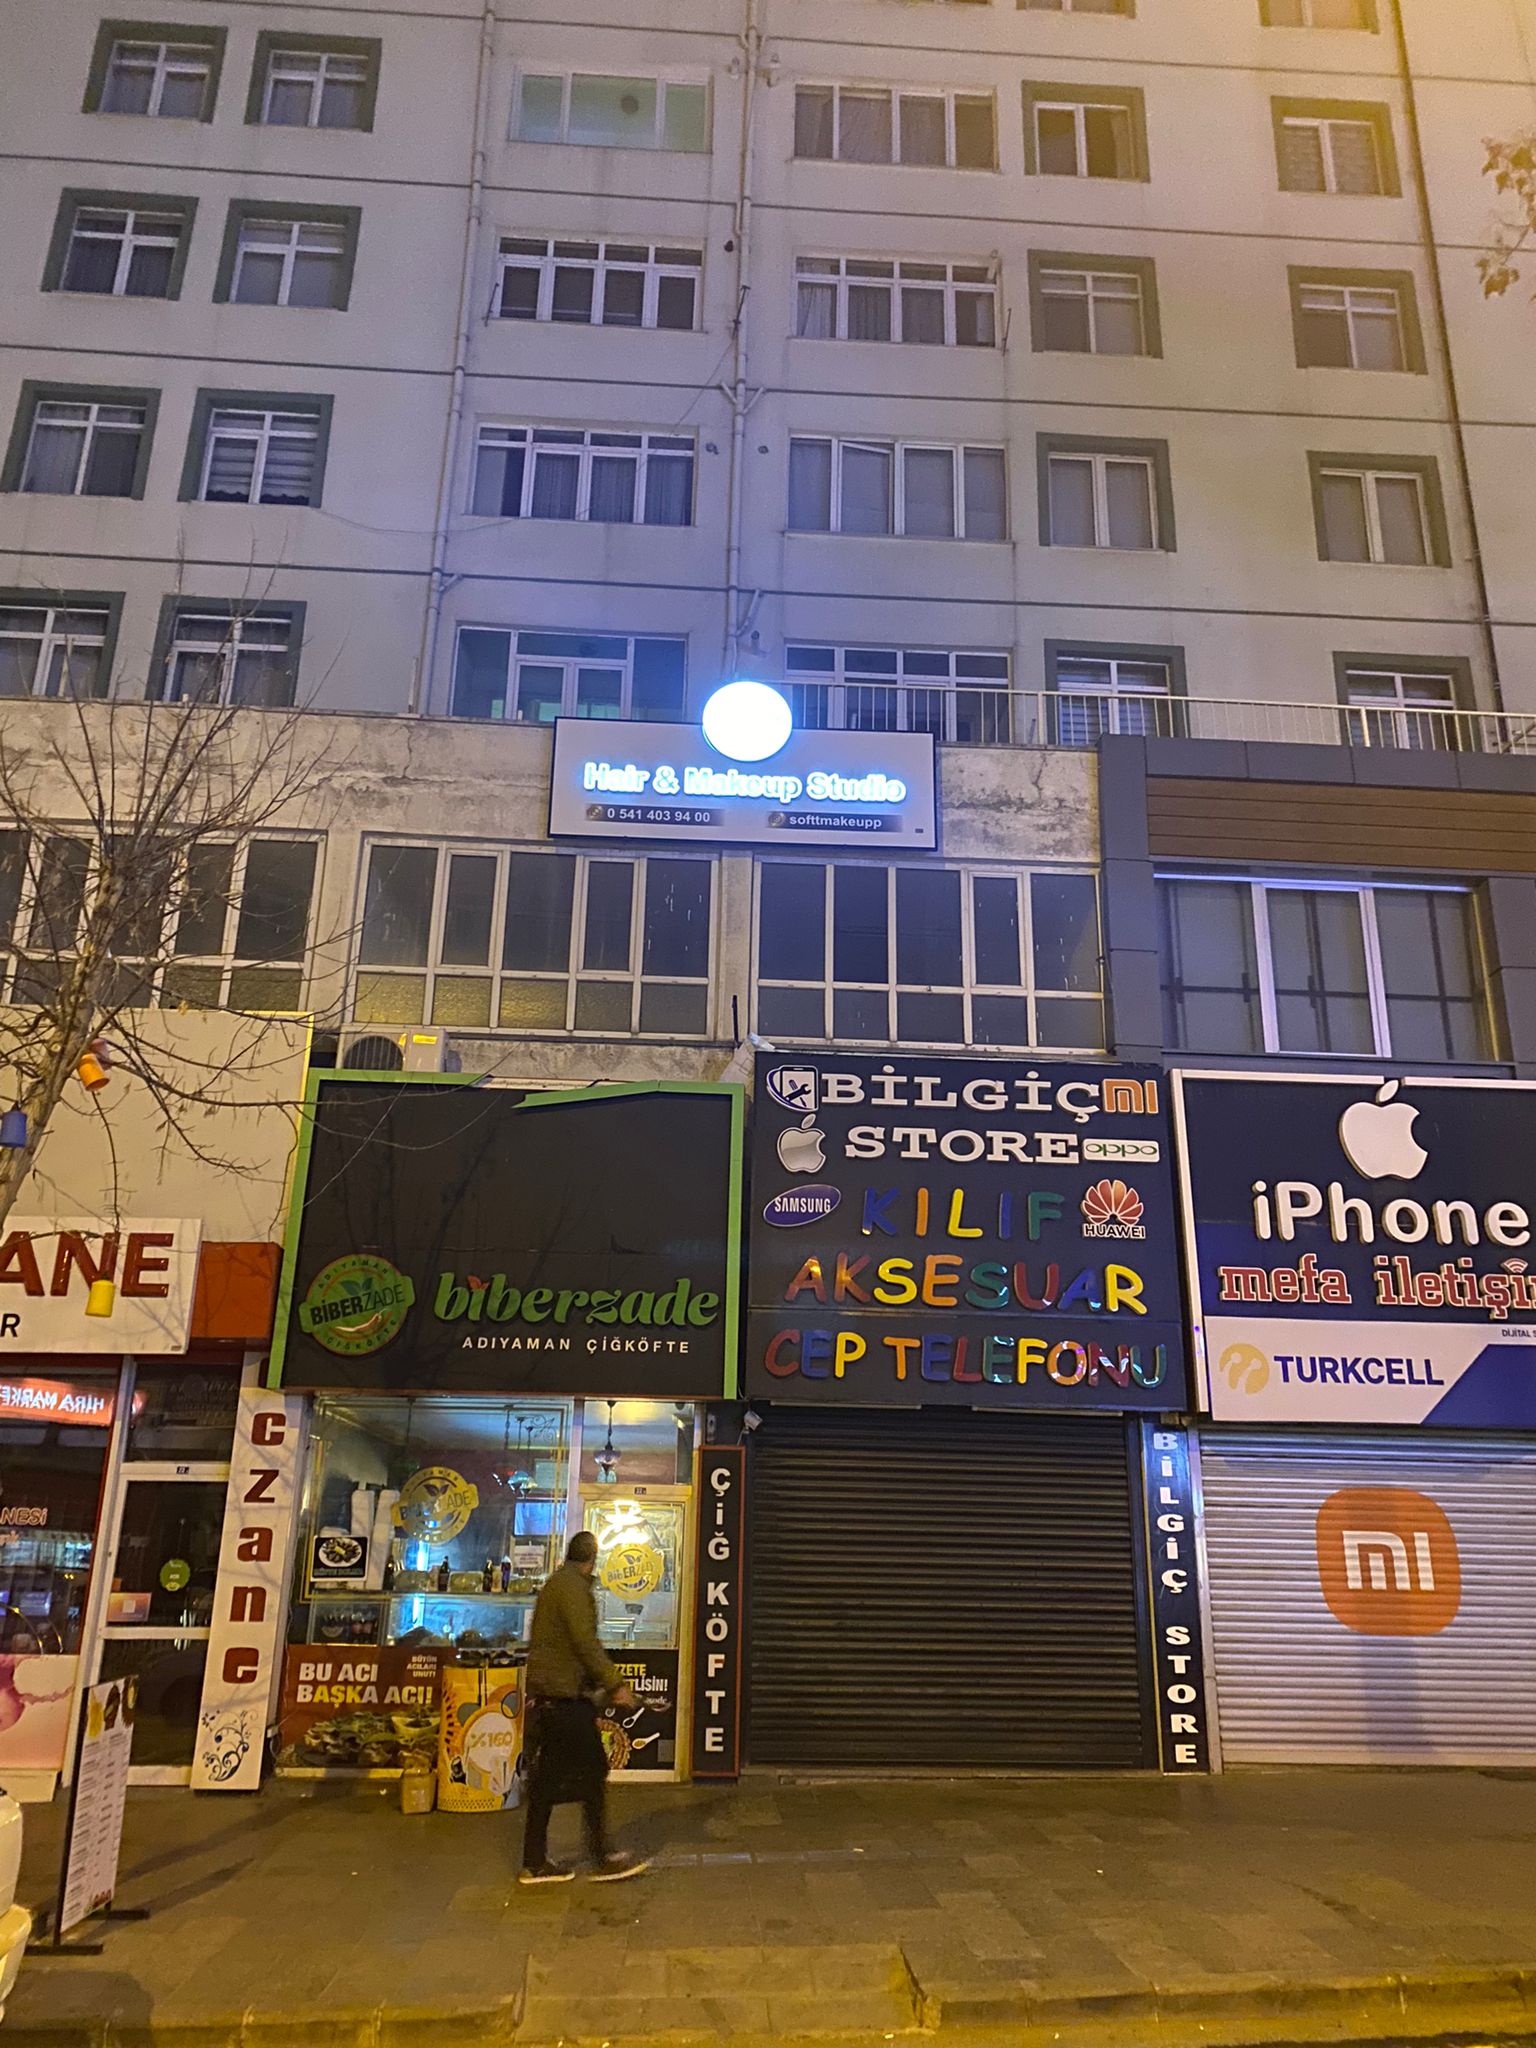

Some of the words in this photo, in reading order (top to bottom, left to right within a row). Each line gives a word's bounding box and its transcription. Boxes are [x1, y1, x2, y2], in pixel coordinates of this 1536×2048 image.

[585, 763, 648, 792] Hair
[653, 766, 679, 794] &
[684, 767, 802, 803] Makeup
[806, 772, 906, 802] Studio
[607, 808, 614, 818] 0
[619, 808, 642, 820] 541
[647, 809, 671, 821] 403
[674, 811, 690, 822] 94
[694, 811, 710, 823] 00
[789, 815, 882, 829] softtmakeupp
[822, 1065, 1100, 1123] BİLGİÇ
[845, 1126, 1080, 1164] STORE
[774, 1196, 831, 1214] SAMSUNG
[862, 1187, 1065, 1241] KILIF
[1252, 1180, 1531, 1246] iPhone
[1083, 1223, 1146, 1240] HUAWEI
[434, 1272, 718, 1327] biberzade
[784, 1251, 1148, 1315] AKSESUAR
[1218, 1253, 1352, 1304] mefa
[310, 1283, 405, 1326] BİBERZADE
[462, 1336, 571, 1351] ADIYAMAN
[586, 1335, 689, 1354] ÇİĞKÖFTE
[765, 1328, 867, 1379] CEP
[883, 1335, 1168, 1389] TELEFONU
[1274, 1355, 1445, 1386] TURKCELL
[707, 1468, 731, 1560] ÇİĞ
[1153, 1433, 1188, 1594] BİLGİÇ
[299, 1663, 332, 1681] BU
[337, 1663, 379, 1682] ACI
[705, 1582, 729, 1752] KÖFTE
[297, 1684, 379, 1708] BAŞKA
[384, 1686, 433, 1704] ACI!
[1166, 1626, 1199, 1764] STORE
